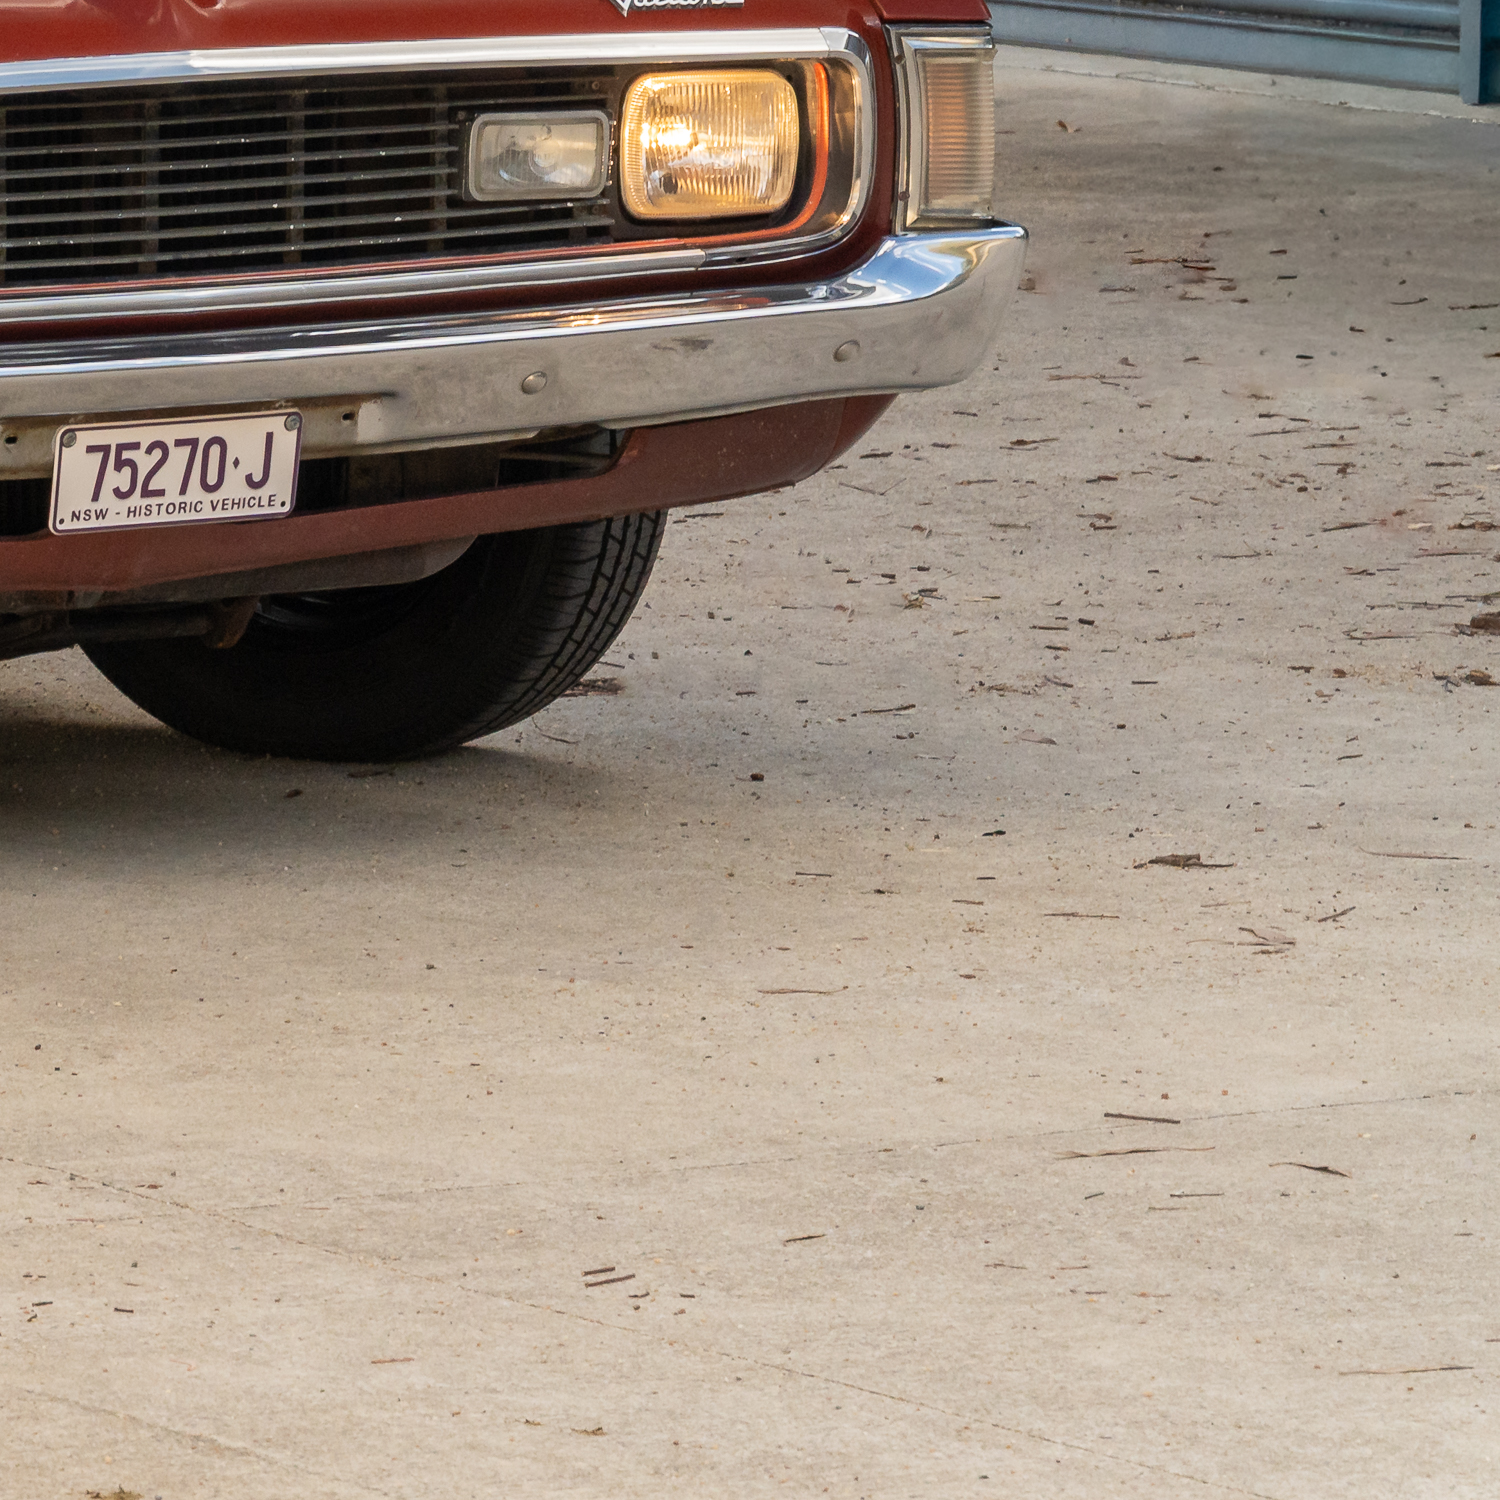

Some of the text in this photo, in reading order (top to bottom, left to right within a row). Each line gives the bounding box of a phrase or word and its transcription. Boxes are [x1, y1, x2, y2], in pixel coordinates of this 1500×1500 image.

[70, 507, 109, 523] NSW
[126, 500, 204, 519] HISTORIC
[210, 493, 277, 513] VEHICLE
